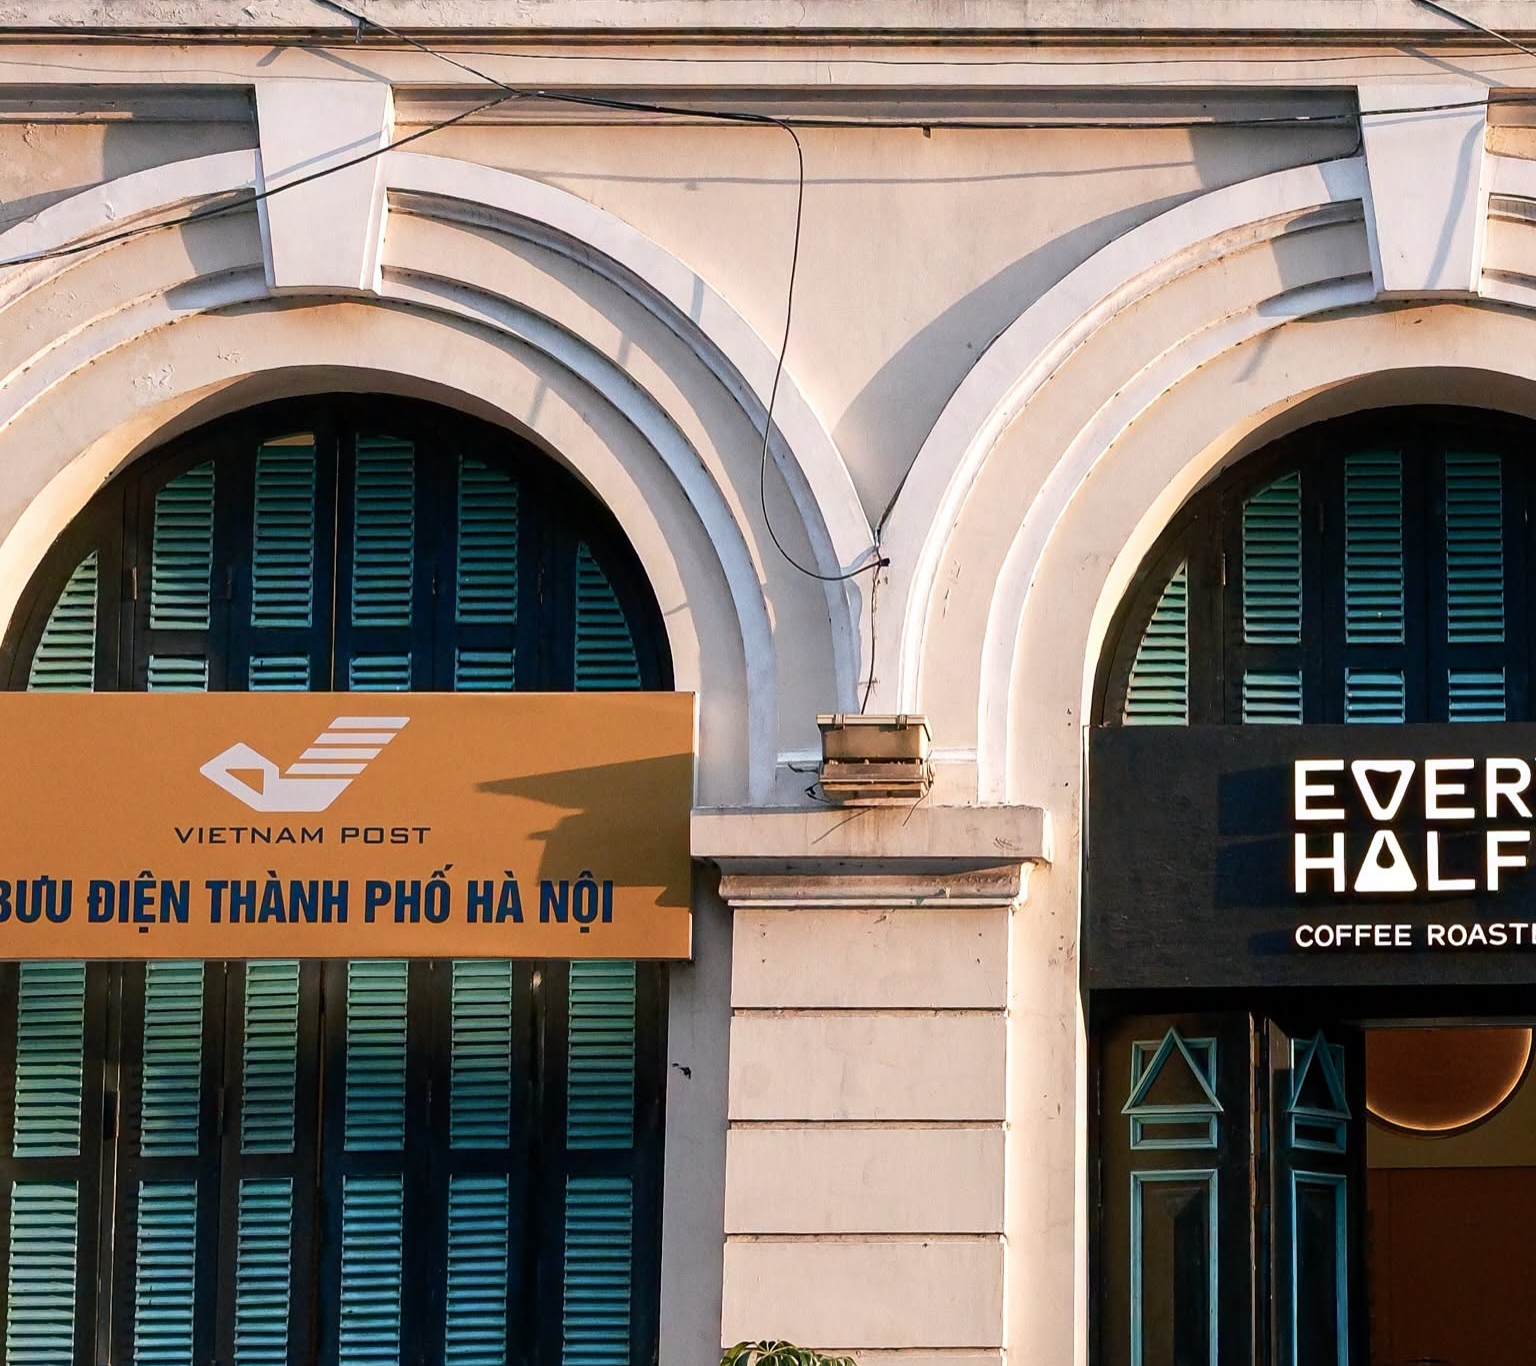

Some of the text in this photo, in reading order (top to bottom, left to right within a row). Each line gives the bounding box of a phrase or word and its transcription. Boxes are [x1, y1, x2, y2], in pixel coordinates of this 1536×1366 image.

[175, 828, 430, 843] VIETNAM POST
[1295, 830, 1530, 892] HALF
[87, 871, 189, 933] ĐIỆN
[206, 871, 348, 923] THÀNH
[365, 864, 453, 923] PHỐ
[467, 871, 523, 923] HÀ
[540, 871, 614, 933] NỘI
[1296, 925, 1411, 947] COFFEE
